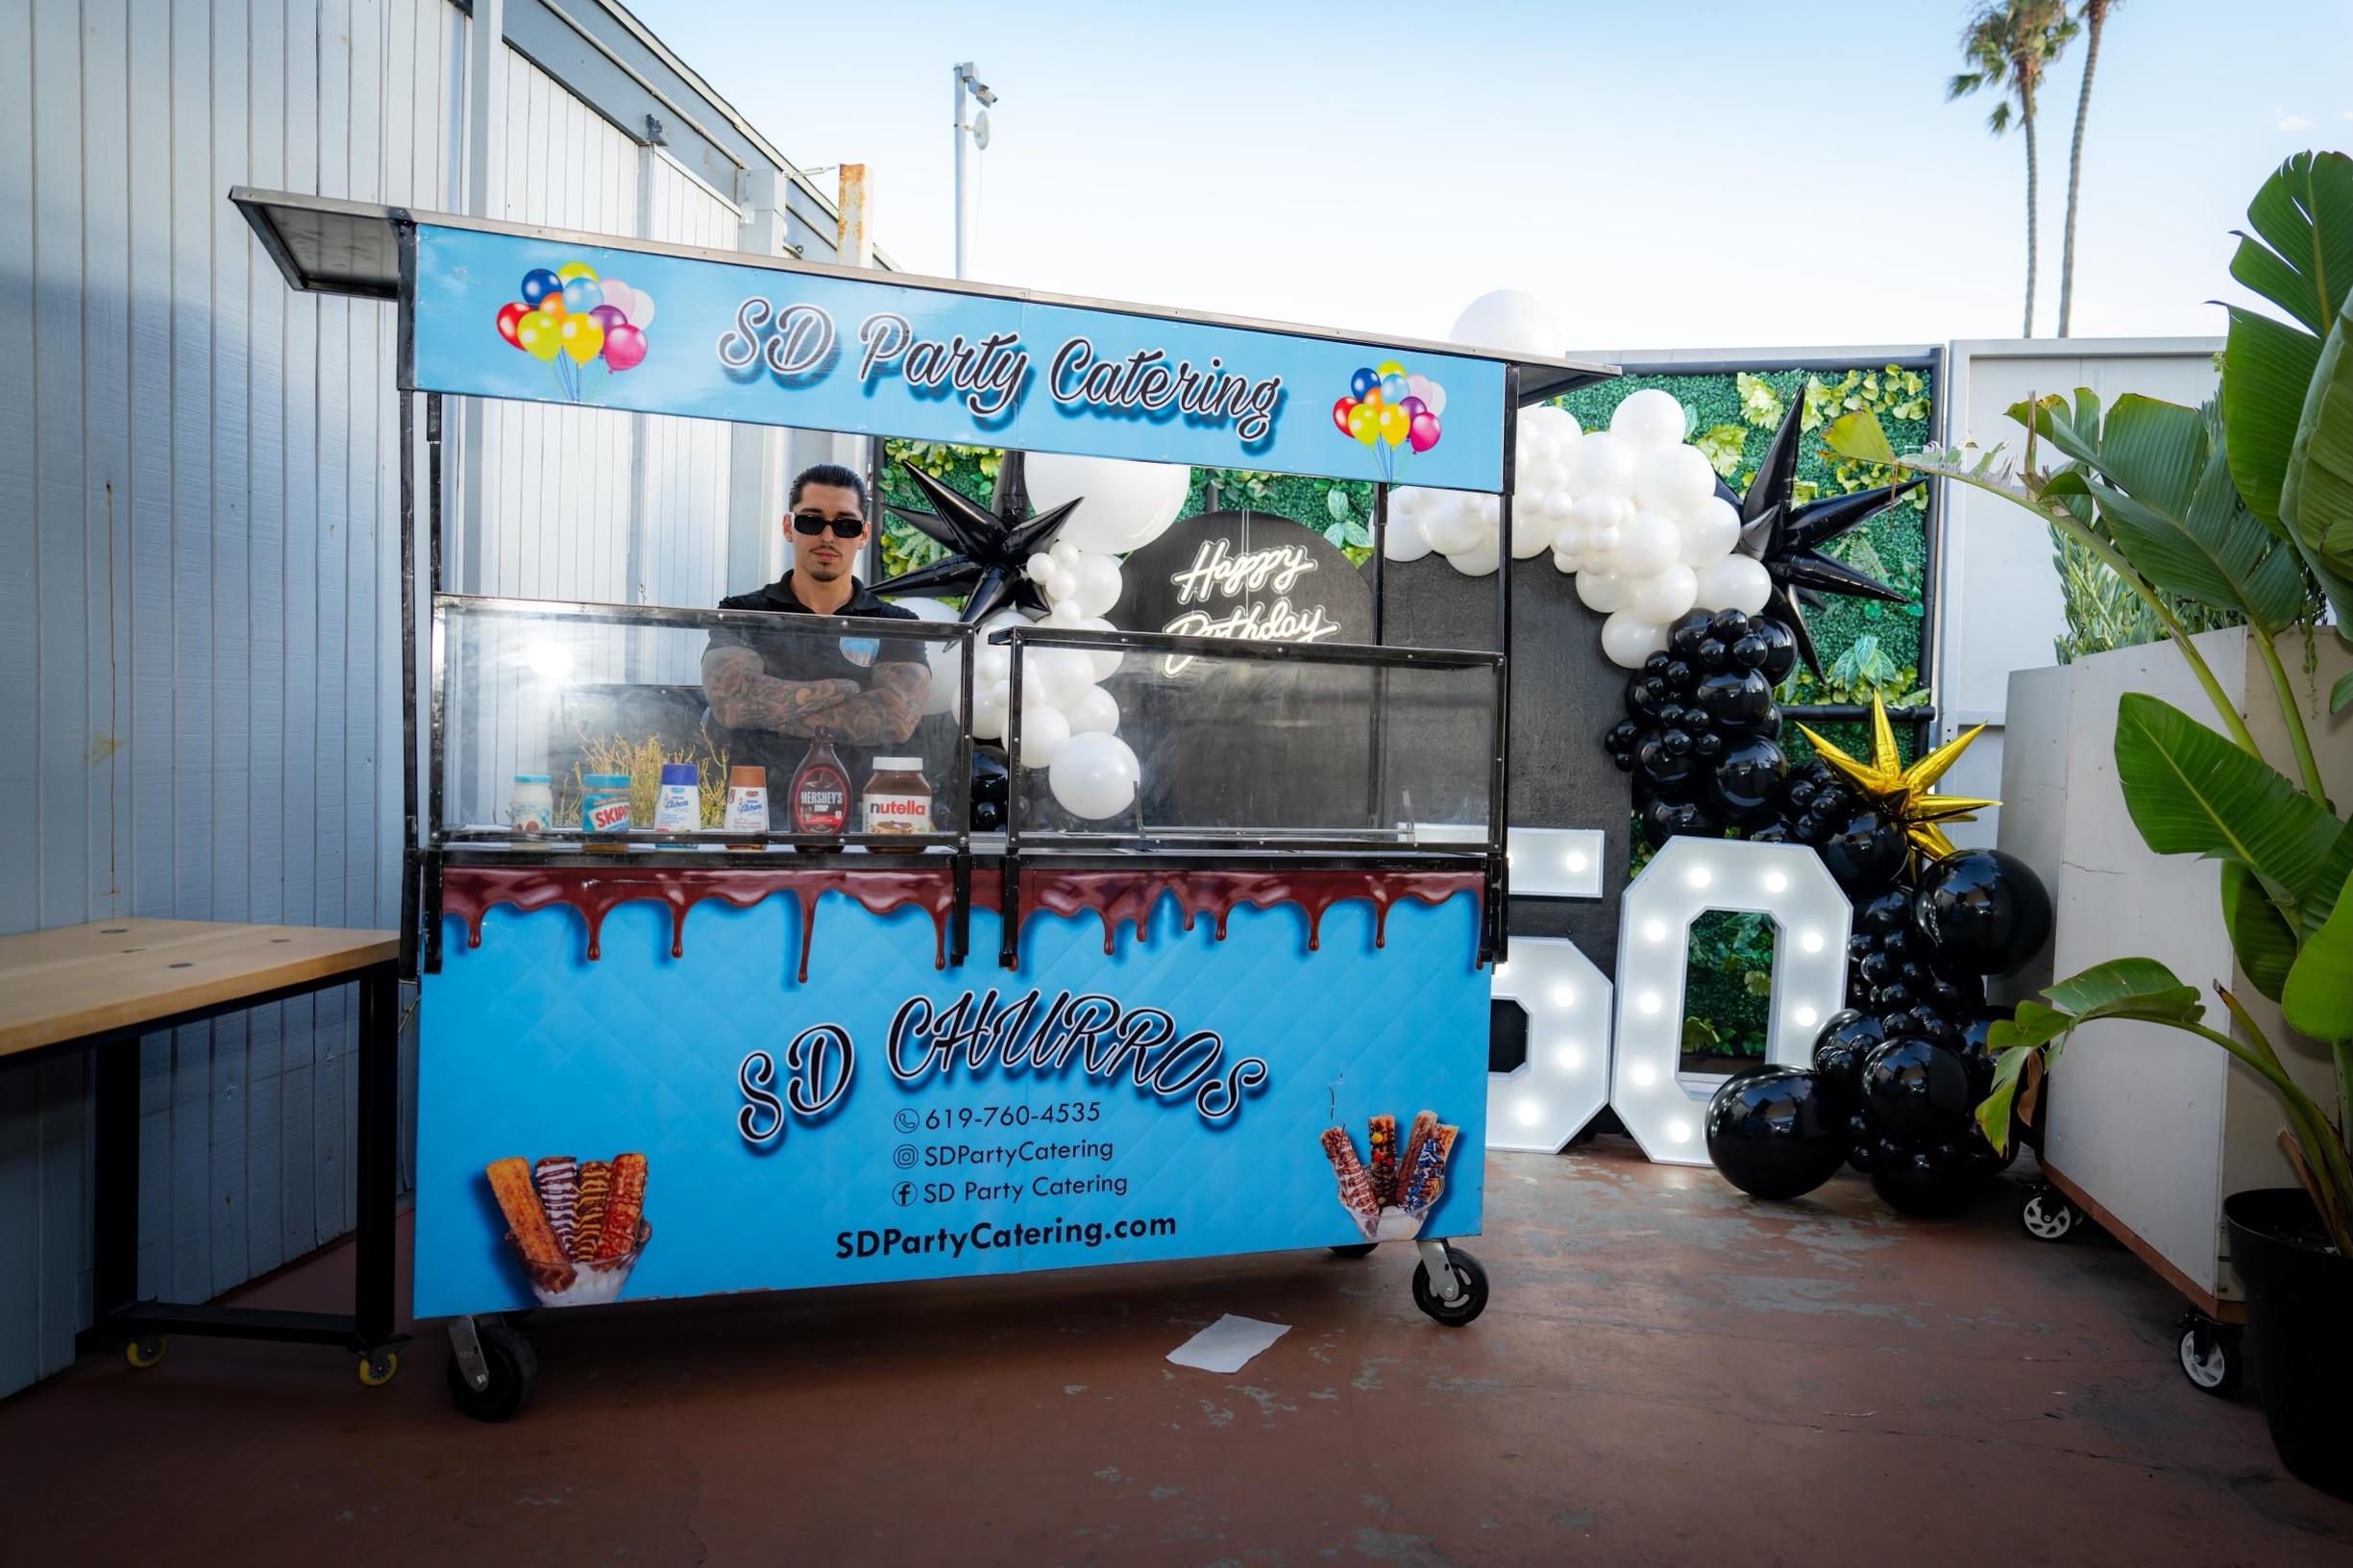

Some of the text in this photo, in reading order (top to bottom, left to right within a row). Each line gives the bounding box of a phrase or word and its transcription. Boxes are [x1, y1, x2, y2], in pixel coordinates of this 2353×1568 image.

[716, 296, 1284, 442] SD Party Catering
[1171, 539, 1316, 603] Happy
[800, 791, 843, 804] HERSHEY'S
[870, 799, 926, 816] nutella
[738, 988, 1269, 1142] SD CHURROS
[925, 1102, 1100, 1130] 619-760-4535
[924, 1139, 1113, 1167] SDPartyCatering
[923, 1183, 954, 1204] SD
[965, 1182, 1023, 1204] Party
[1032, 1174, 1128, 1196] Catering
[835, 1216, 1176, 1260] SDPartyCatering.com
